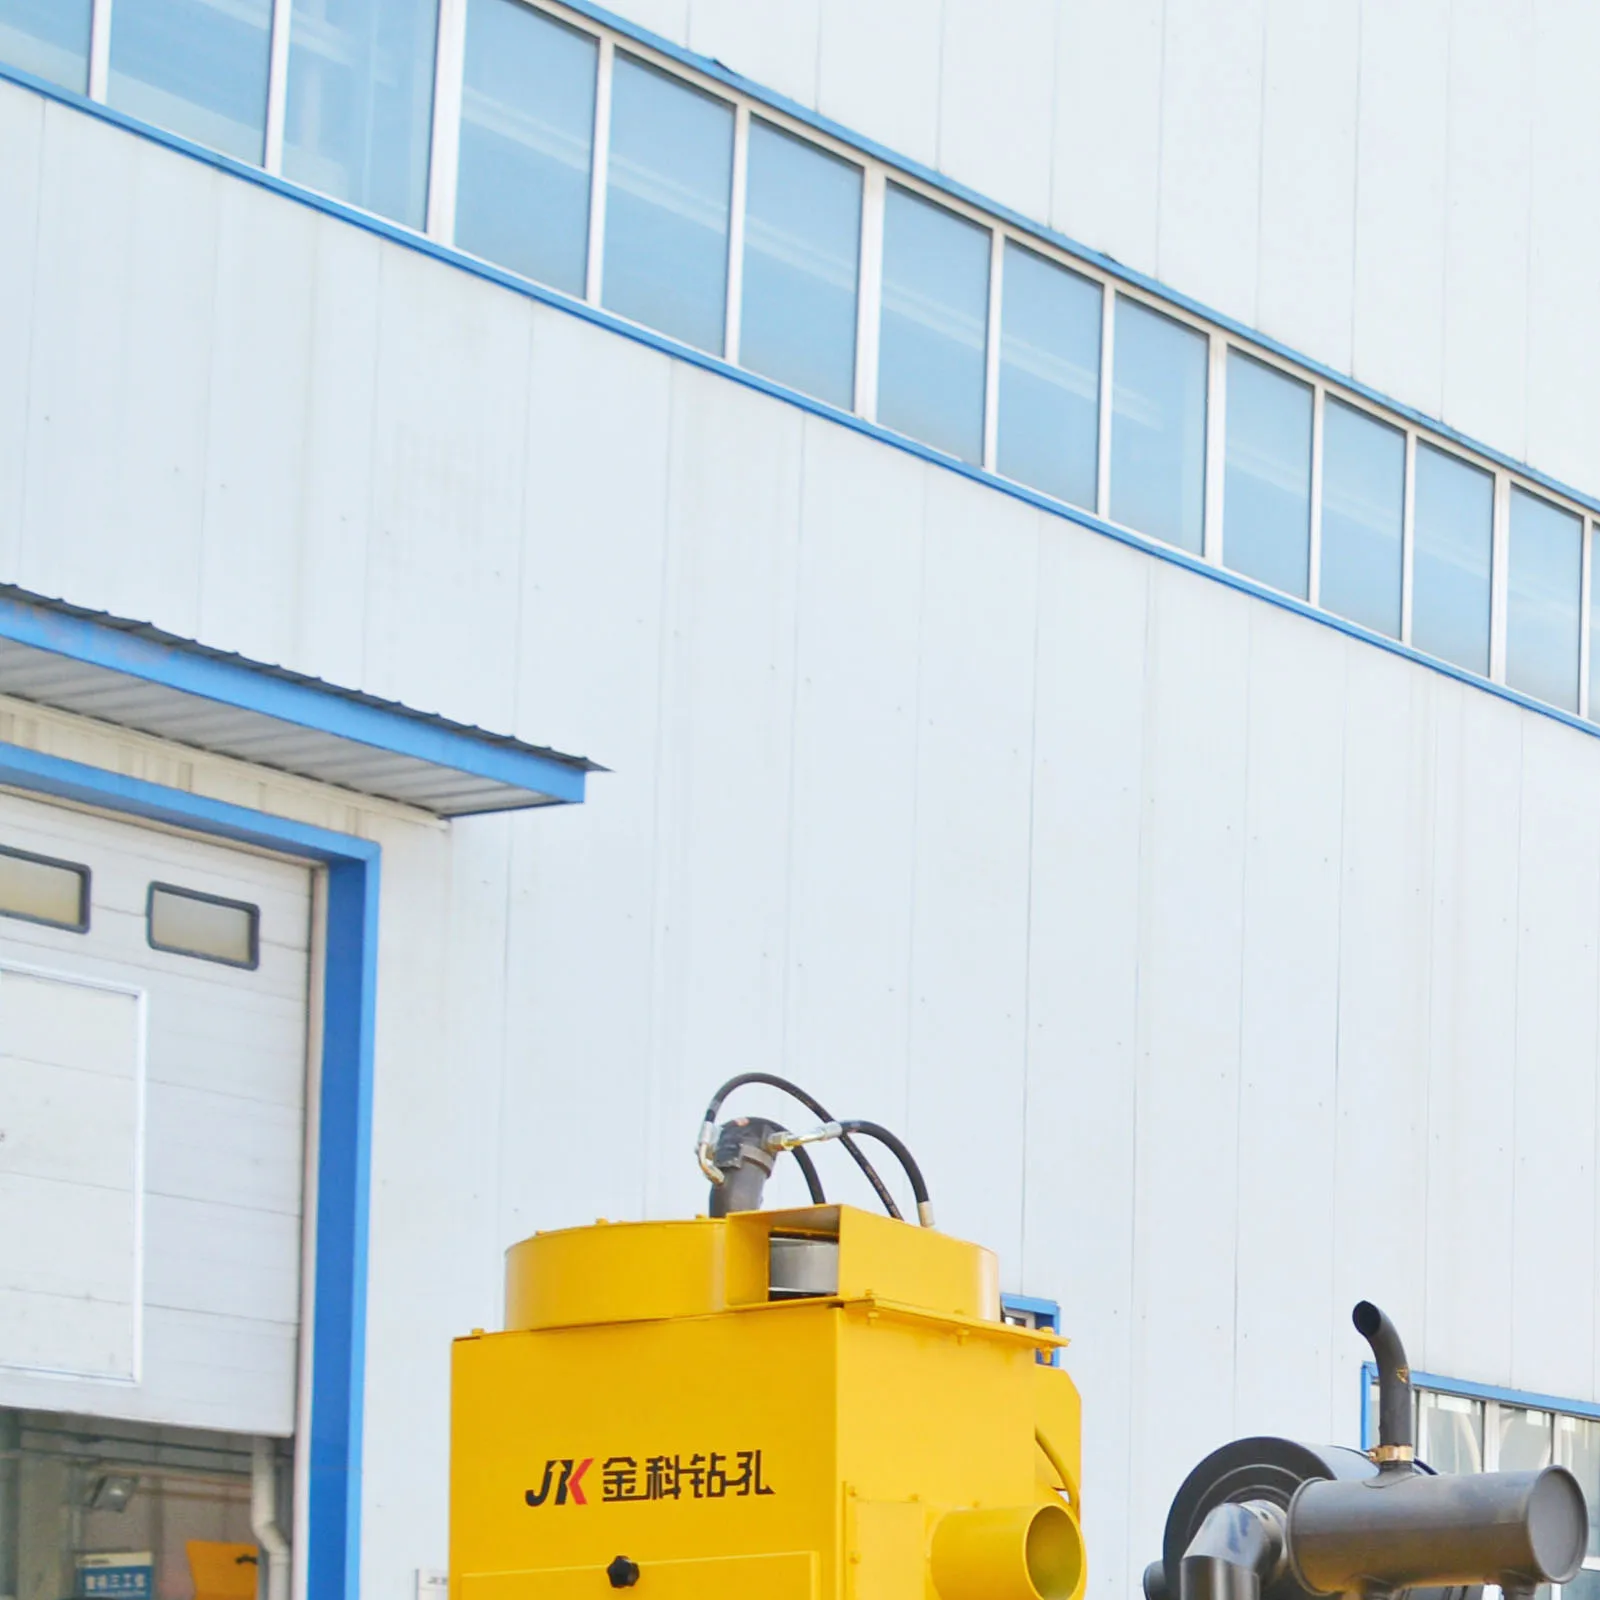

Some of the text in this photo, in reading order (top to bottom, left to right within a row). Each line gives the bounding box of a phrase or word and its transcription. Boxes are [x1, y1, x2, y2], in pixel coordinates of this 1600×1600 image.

[525, 1449, 776, 1507] JK 金科钻孔
